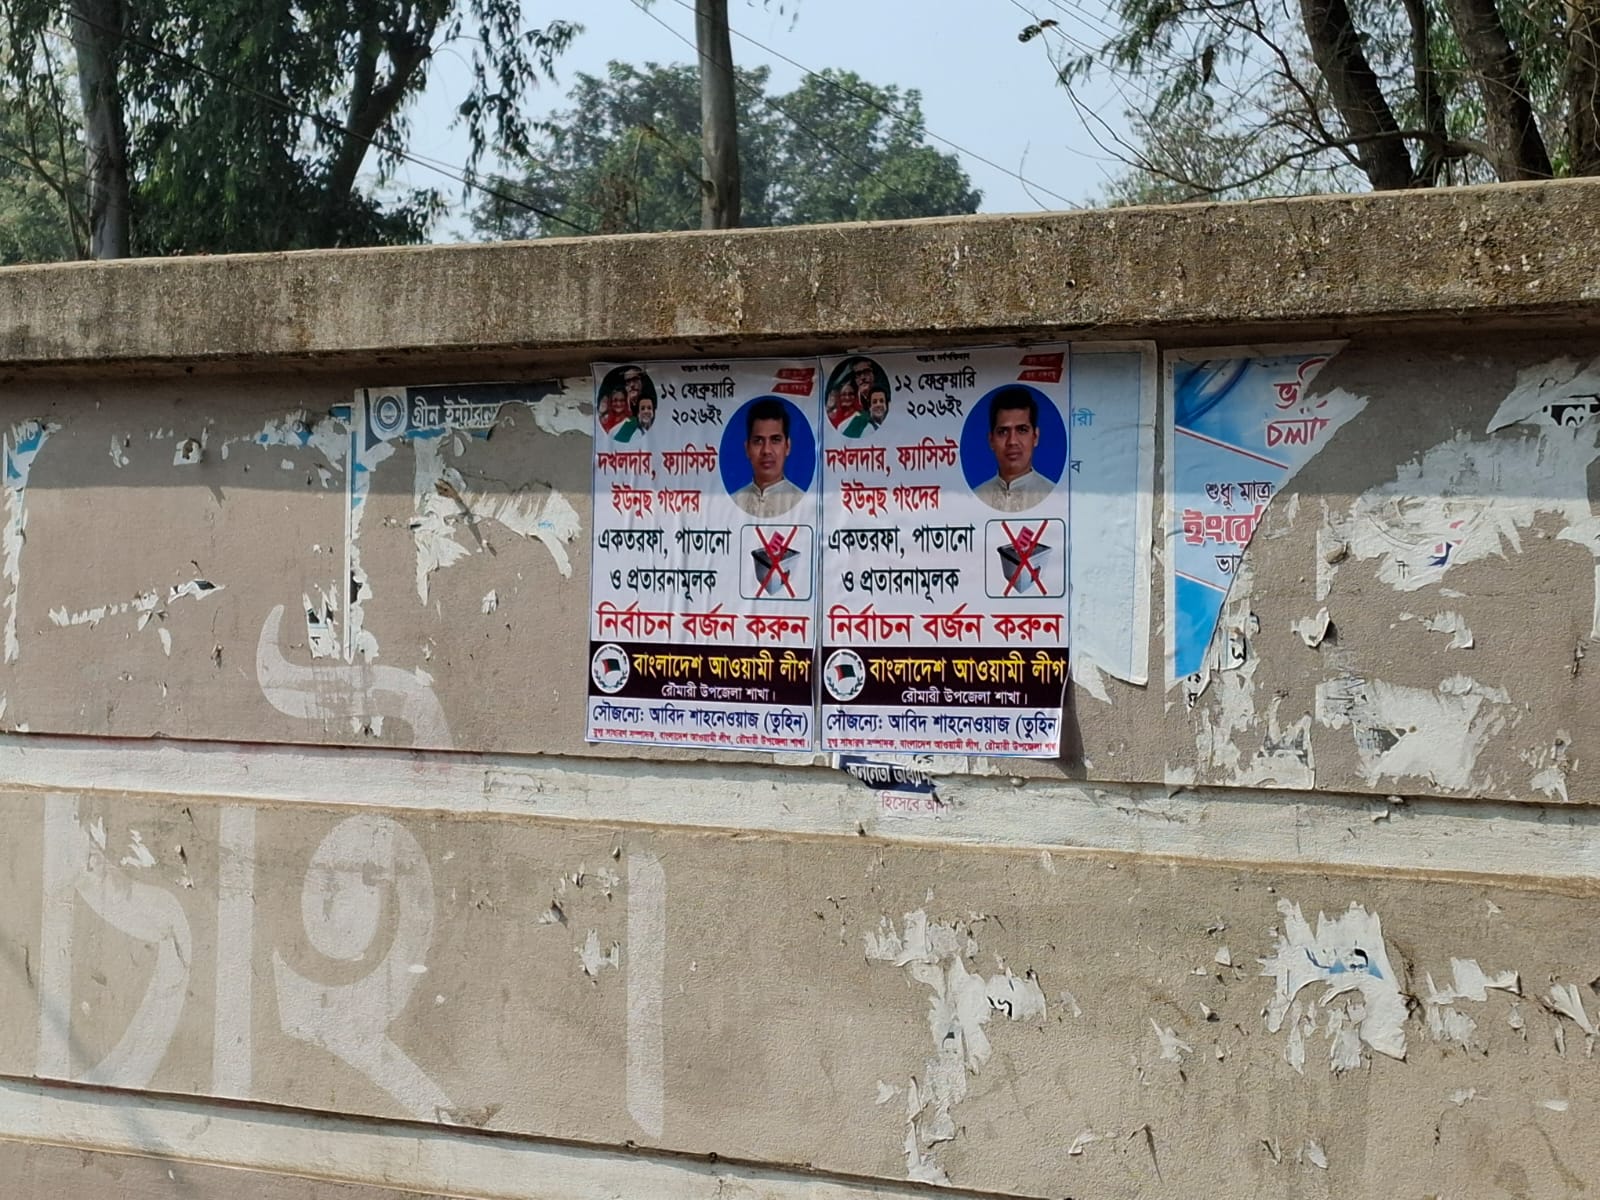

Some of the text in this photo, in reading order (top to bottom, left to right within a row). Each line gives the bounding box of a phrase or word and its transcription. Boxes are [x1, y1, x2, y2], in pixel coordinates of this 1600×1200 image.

[661, 383, 678, 401] ১২
[894, 374, 914, 393] ১২
[671, 404, 723, 427] ২০২৬ইং
[906, 394, 963, 420] ২০২৬ইং
[597, 443, 719, 481] দখলদার, ফ্যাসিস্ট
[825, 436, 959, 477] দখলদার, ফ্যাসিস্ট
[611, 482, 701, 520] ইউনুছ গংদের
[841, 480, 941, 519] ইউনুছ গংদের
[1237, 480, 1272, 502] মাত্র
[598, 527, 732, 559] একতরফা, পাতানো
[828, 523, 976, 559] একতরফা, পাতানো
[610, 566, 718, 602] ও প্রতারনামূলক
[841, 566, 961, 603] ও প্রতারনামূলক
[595, 600, 810, 643] নির্বাচন বর্জন করুন
[827, 603, 1064, 644] নির্বাচন বর্জন করুন
[632, 653, 703, 679] বাংলাদেশ
[708, 649, 775, 681] আওয়ামী
[779, 652, 811, 683] লীগ
[868, 658, 946, 684] বাংলাদেশ
[951, 651, 1026, 684] আওয়ামী
[1030, 650, 1067, 685] লীগ
[661, 681, 698, 698] রৌমারী
[700, 683, 743, 701] উপজেলা
[901, 686, 940, 704] রৌমারী
[943, 687, 992, 705] উপজেলা
[649, 703, 685, 726] আবিদ
[688, 709, 760, 730] শাহনেওয়াজ
[763, 708, 809, 736] (তুহিন)
[888, 710, 928, 734] আবিদ
[932, 714, 1011, 735] শাহনেওয়াজ
